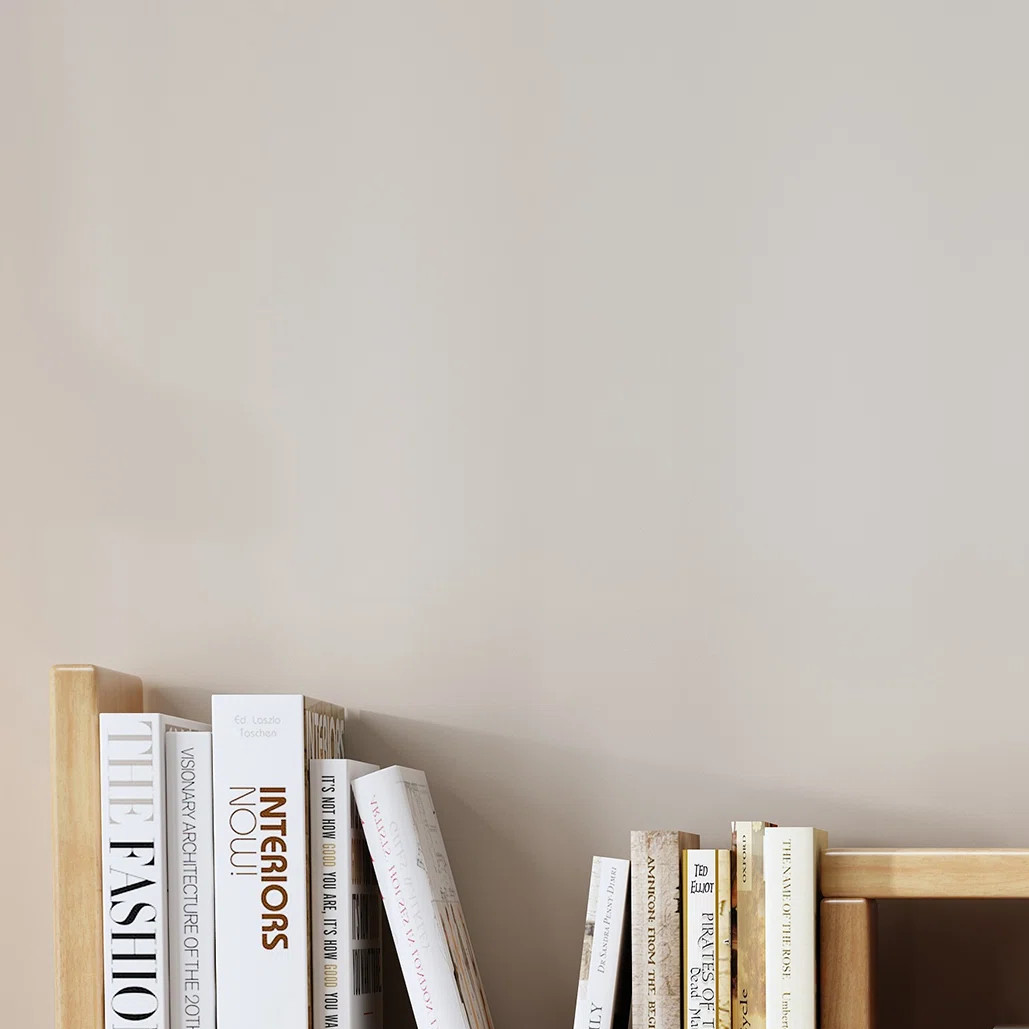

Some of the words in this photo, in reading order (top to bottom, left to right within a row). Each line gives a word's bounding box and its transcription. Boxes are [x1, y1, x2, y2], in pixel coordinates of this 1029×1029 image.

[107, 721, 155, 825] THE
[180, 747, 196, 821] VISIONARY
[321, 775, 336, 793] IT'S
[322, 796, 336, 815] NOT
[229, 786, 258, 876] NOW!
[322, 818, 336, 840] HOW
[322, 843, 337, 868] GOOD
[182, 821, 199, 935] ARCHITECTURE
[259, 787, 289, 950] INTERIORS
[323, 871, 337, 890] YOU
[782, 867, 792, 902] NAME
[321, 893, 338, 915] ARE,
[323, 918, 338, 937] IT'S
[183, 937, 199, 958] OF
[323, 939, 338, 961] HOW
[648, 926, 657, 966] FROM
[697, 912, 715, 983] PIRATES
[184, 960, 200, 992] THE
[324, 964, 338, 988] GOOD
[648, 969, 657, 996] THE
[690, 967, 701, 999] Dead
[324, 992, 339, 1011] YOU
[700, 987, 715, 1012] OF
